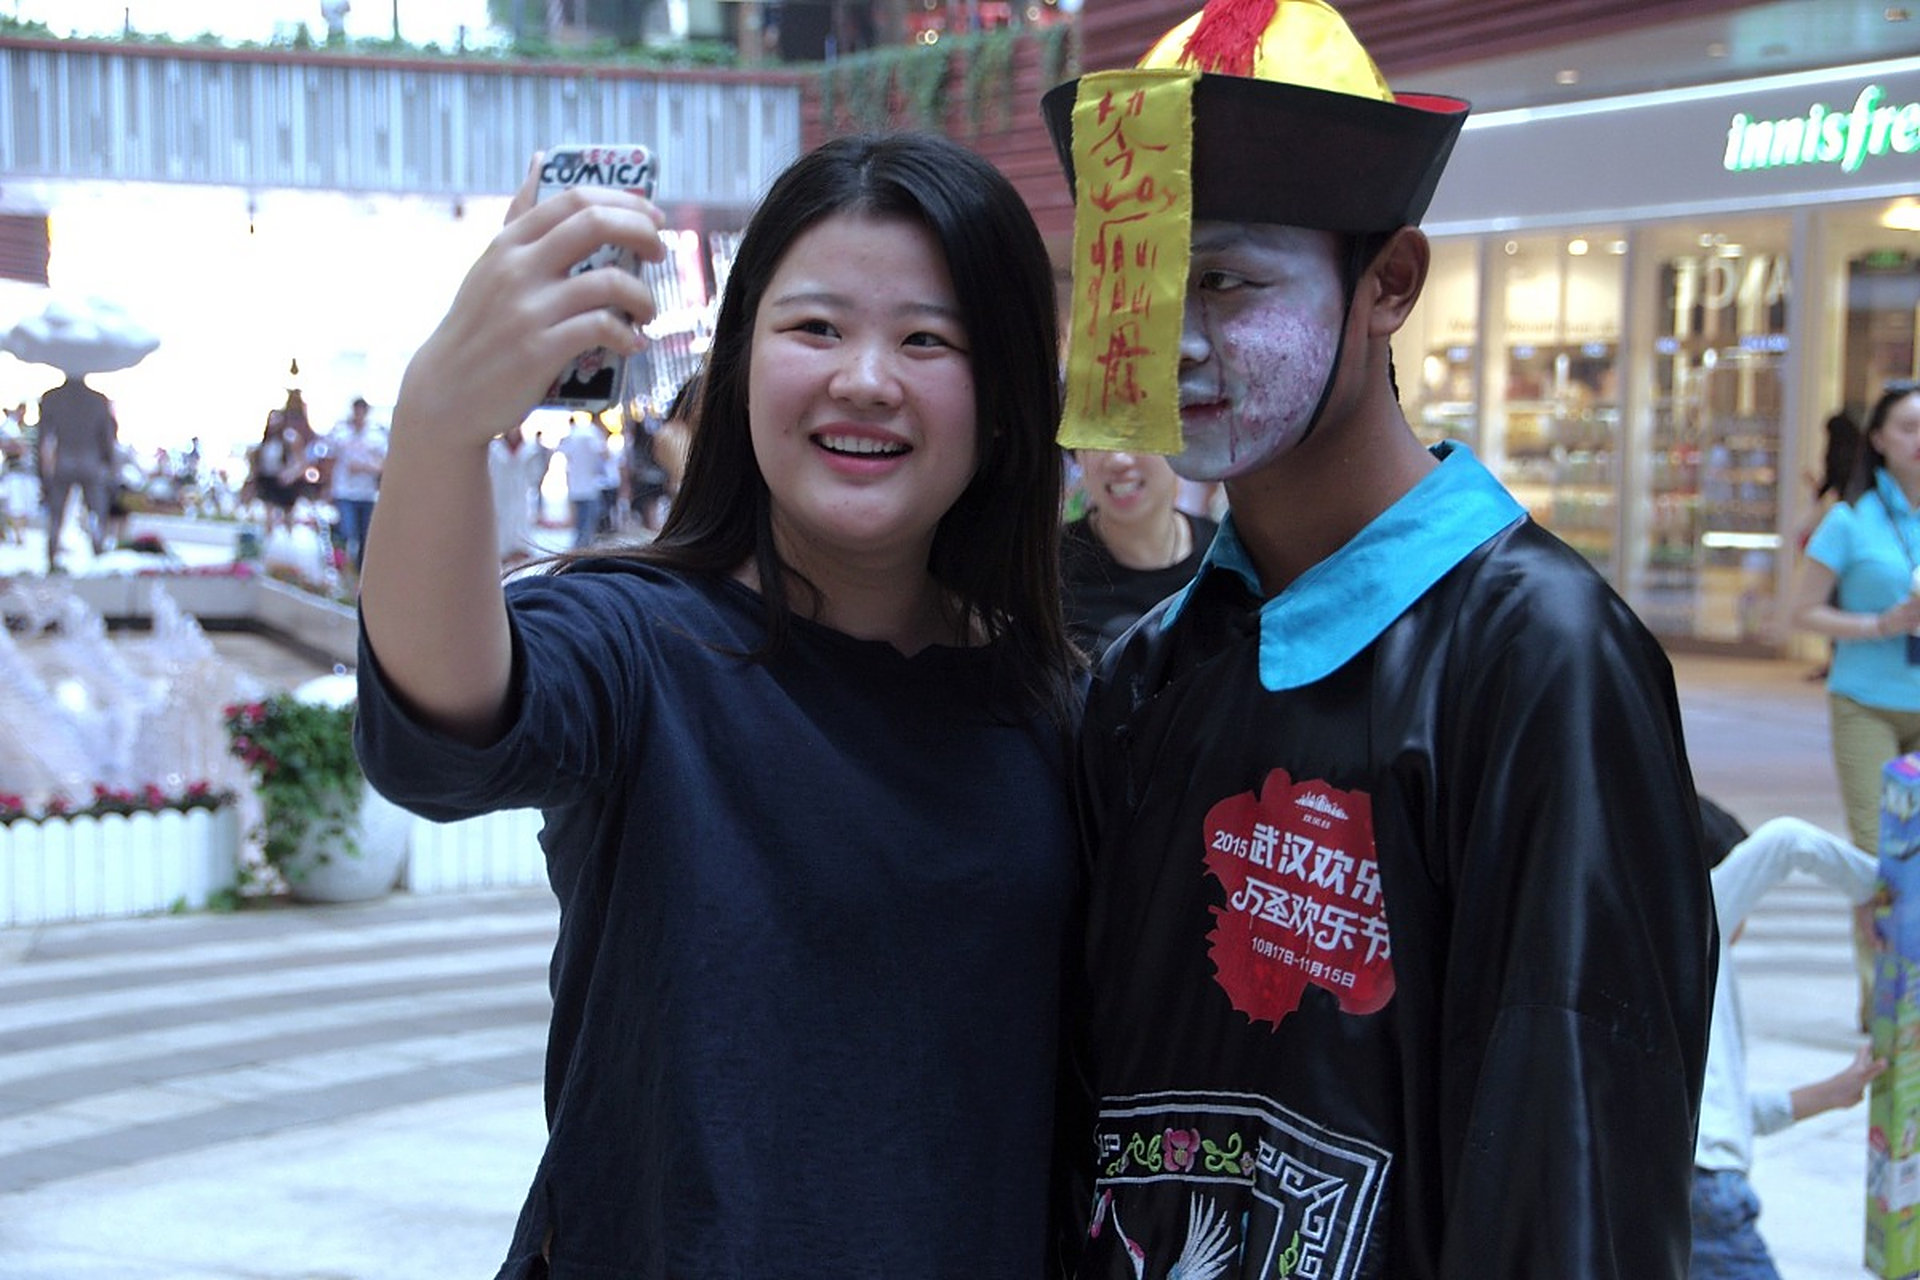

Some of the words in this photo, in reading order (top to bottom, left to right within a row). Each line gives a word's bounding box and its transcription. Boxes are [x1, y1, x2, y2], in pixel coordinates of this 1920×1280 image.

[1724, 84, 1920, 173] innisfre
[541, 163, 649, 186] COMICS
[1231, 876, 1392, 965] 万圣欢乐节
